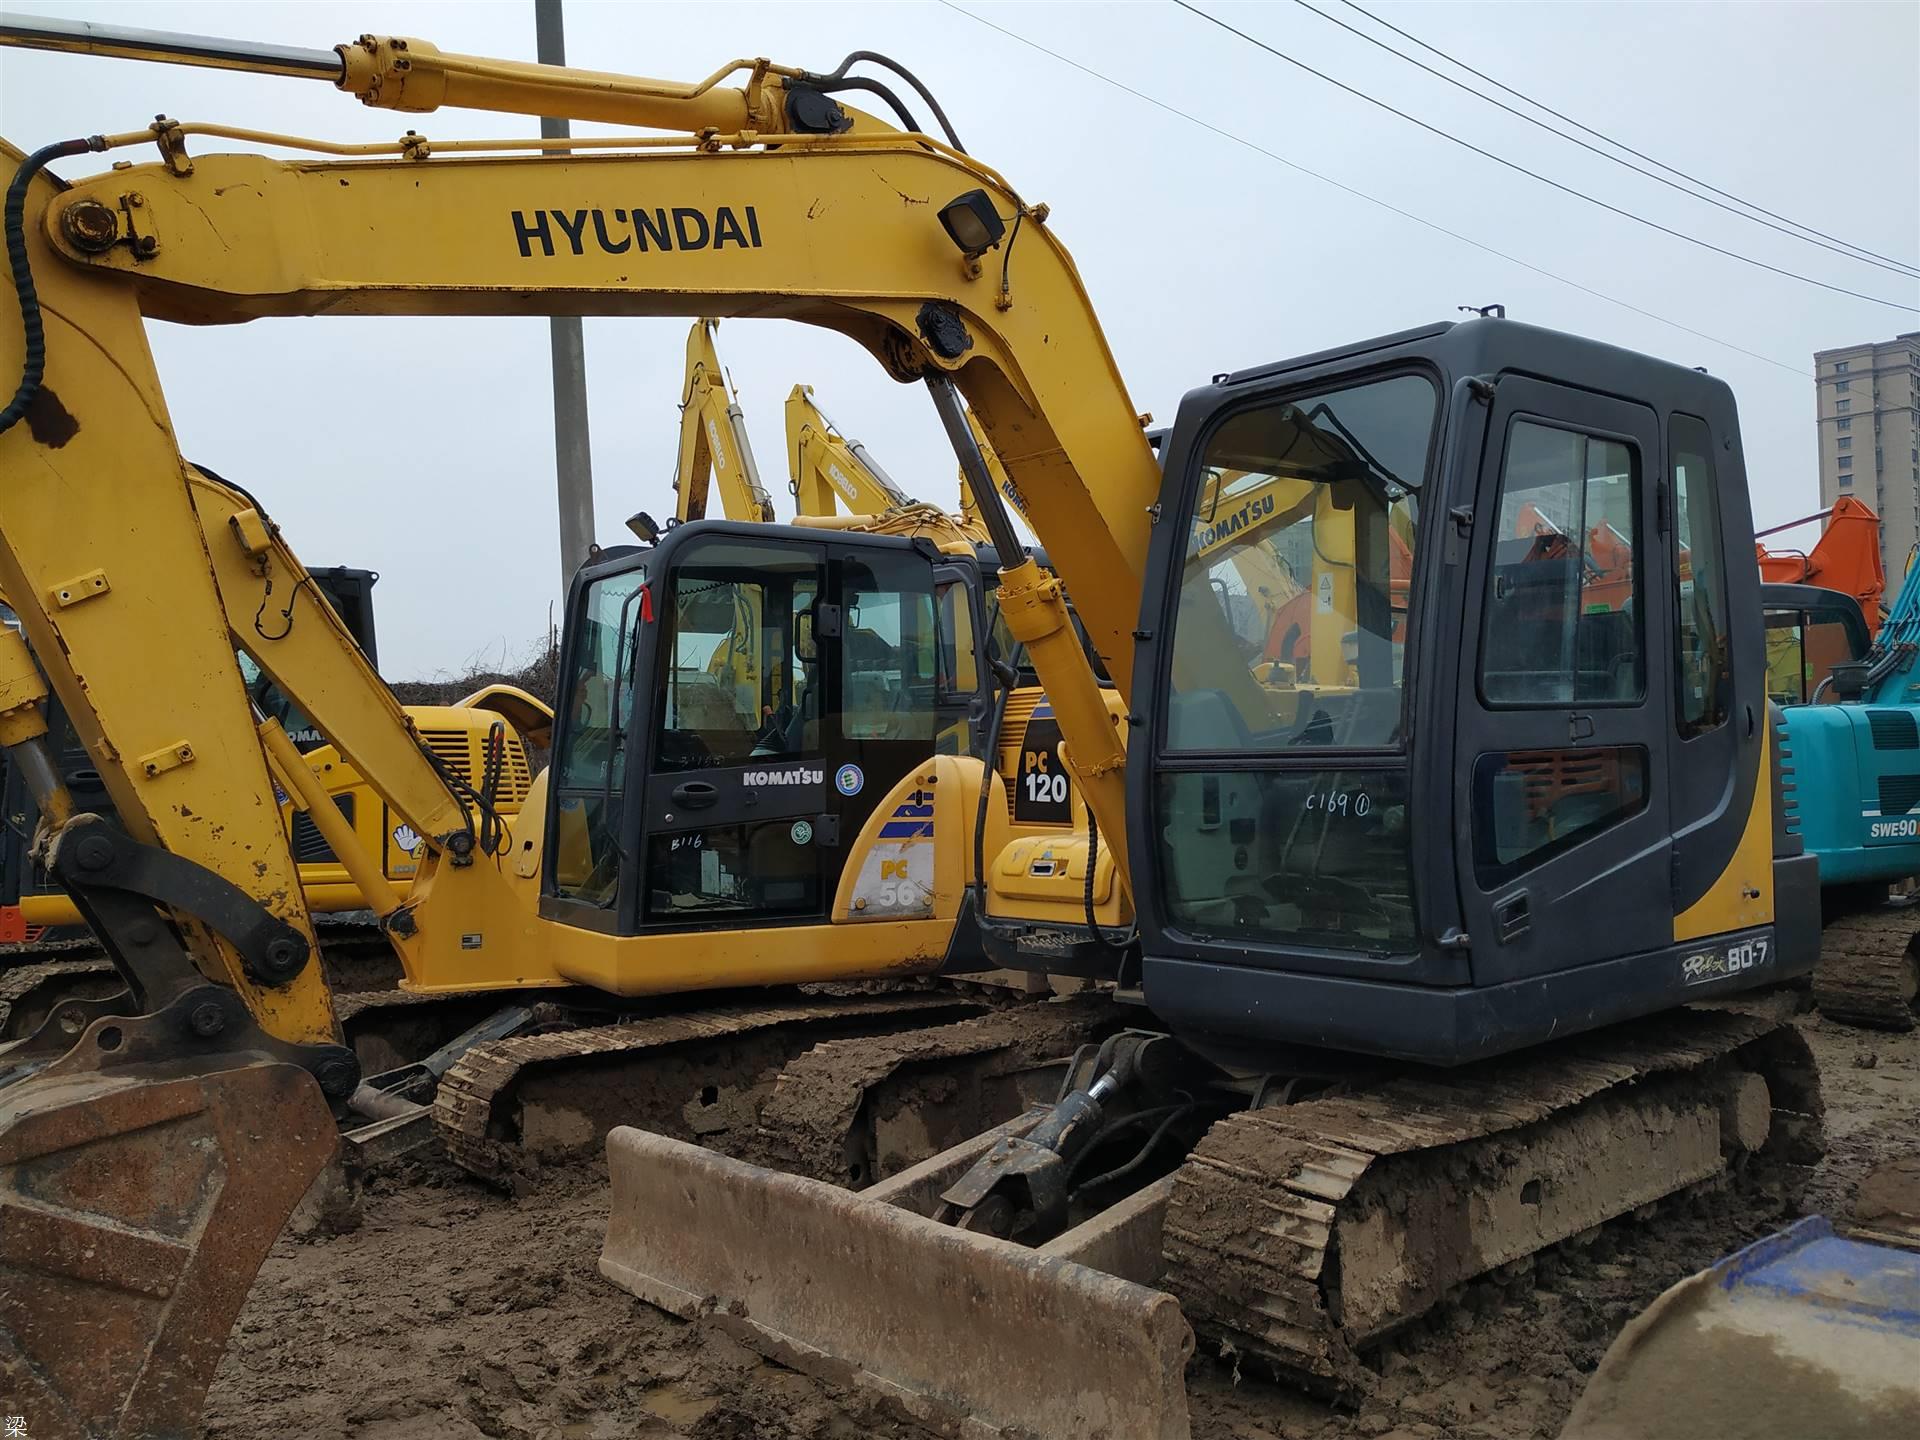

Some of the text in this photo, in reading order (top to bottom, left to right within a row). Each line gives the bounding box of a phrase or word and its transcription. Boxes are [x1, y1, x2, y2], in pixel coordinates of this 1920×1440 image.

[511, 206, 763, 257] HYUNDAI
[708, 419, 726, 470] KOBELCO
[828, 463, 858, 500] KOBELCO
[1025, 751, 1048, 773] PC
[743, 767, 824, 786] KOMATSU
[1026, 773, 1067, 803] 120
[1870, 819, 1920, 838] SWE90
[671, 834, 703, 850] B116
[881, 860, 908, 880] PC
[880, 882, 915, 907] 56
[1728, 941, 1768, 972] 80-7
